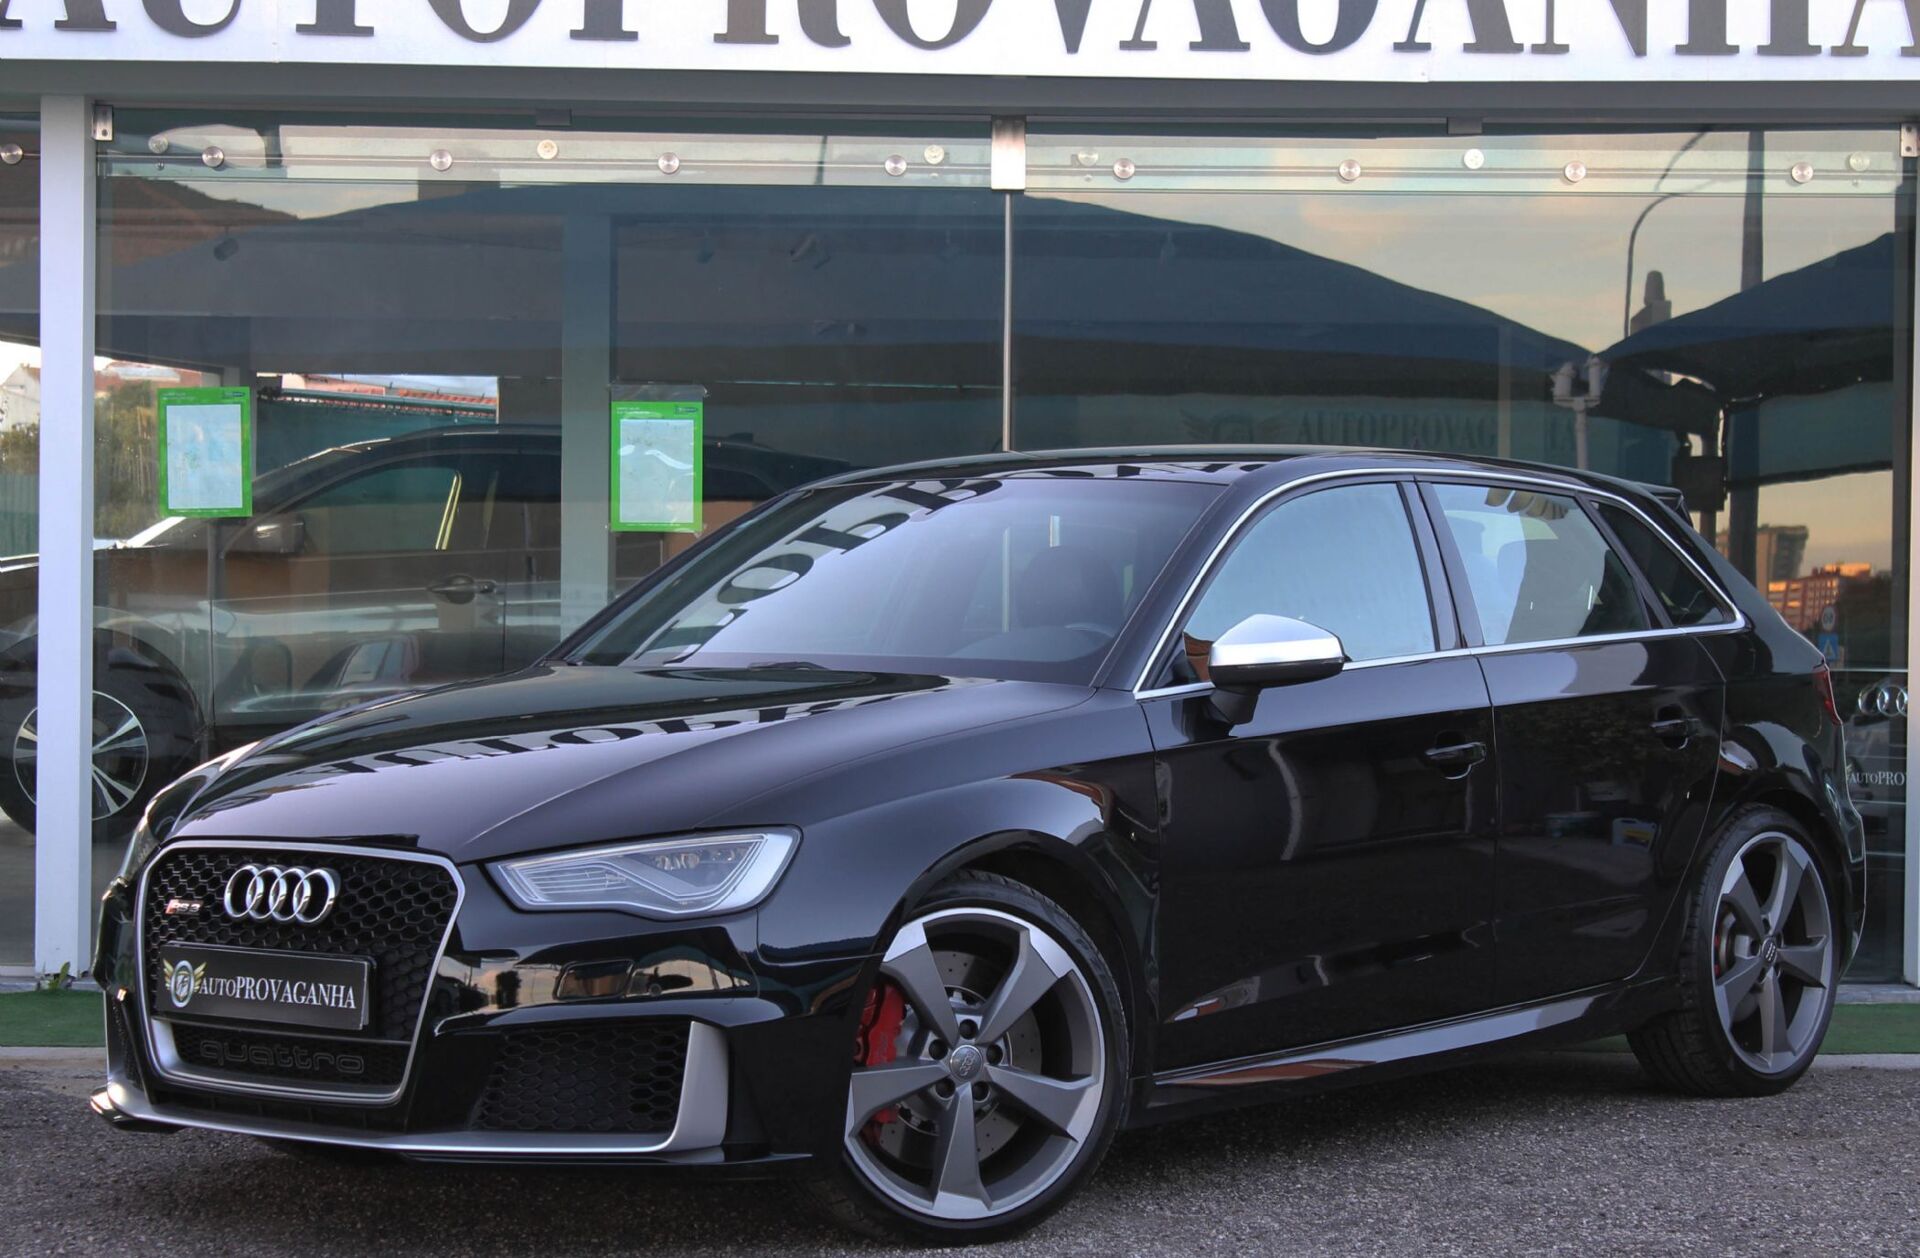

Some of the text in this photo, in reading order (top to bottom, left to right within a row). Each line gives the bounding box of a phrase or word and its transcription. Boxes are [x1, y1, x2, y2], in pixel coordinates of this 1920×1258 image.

[1849, 771, 1905, 786] AUTOPRO
[199, 976, 356, 1009] AUTOPROVAGANHA
[200, 1040, 365, 1074] quattro
